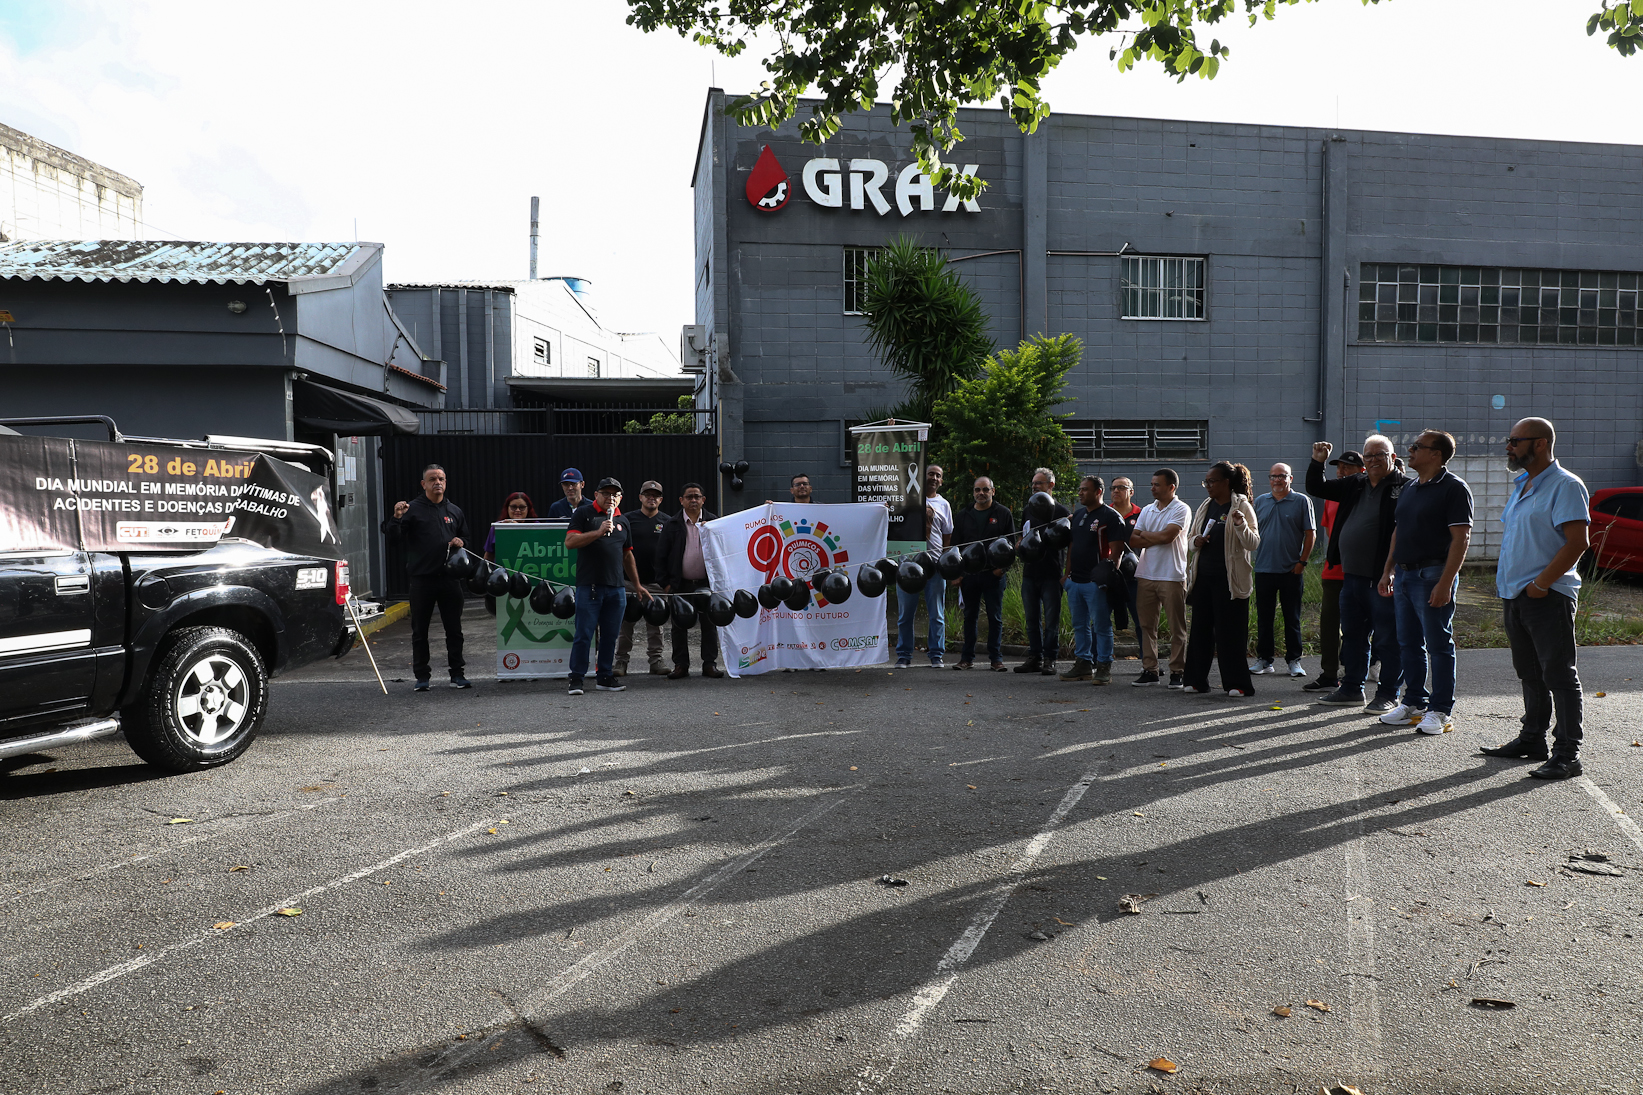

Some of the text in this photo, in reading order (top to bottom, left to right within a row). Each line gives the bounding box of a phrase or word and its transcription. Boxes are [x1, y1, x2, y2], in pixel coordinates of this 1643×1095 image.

[802, 158, 981, 217] GRAX
[857, 442, 921, 454] 28 de Abril
[127, 453, 159, 474] 28
[166, 457, 196, 476] de
[870, 464, 899, 472] MUNDIAL
[869, 473, 899, 482] MEMÓRIA
[35, 477, 64, 491] DIA
[67, 479, 137, 494] MUNDIAL
[140, 481, 161, 495] EM
[165, 482, 228, 496] MEMÓRIA
[243, 482, 286, 504] VÍTIMAS
[288, 494, 301, 507] DE
[872, 483, 898, 492] VÍTIMAS
[53, 498, 140, 512] ACIDENTES
[145, 500, 154, 512] E
[158, 501, 223, 516] DOENÇAS
[744, 518, 767, 530] RUMO
[120, 527, 147, 538] CUT
[517, 541, 569, 558] Abril
[787, 540, 820, 554] QUÍMICOS
[815, 611, 850, 620] FUTURO
